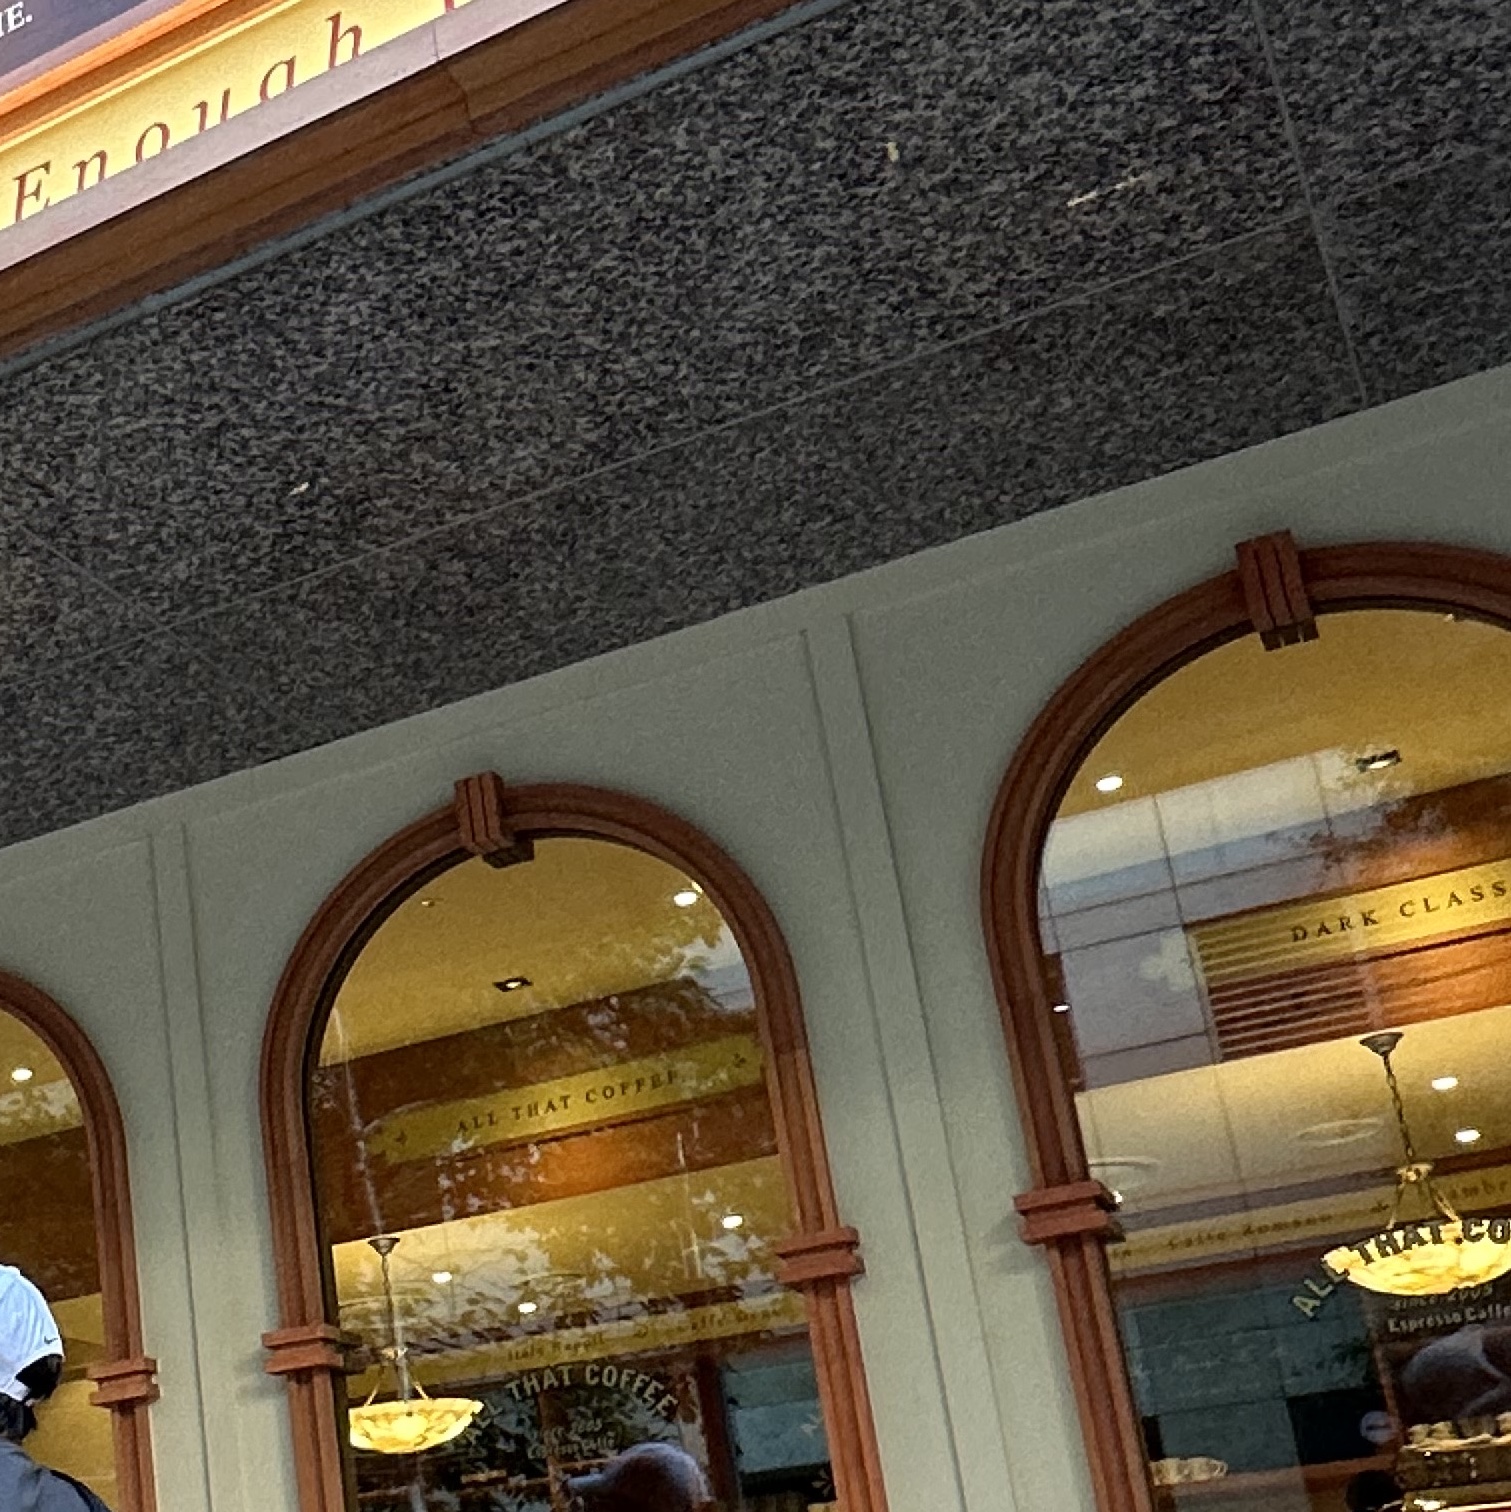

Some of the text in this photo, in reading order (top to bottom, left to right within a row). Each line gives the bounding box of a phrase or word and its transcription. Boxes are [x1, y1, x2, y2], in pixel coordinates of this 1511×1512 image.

[1290, 880, 1507, 942] DARK CLASS
[456, 1109, 498, 1134] ALL
[511, 1094, 571, 1121] THAT
[1291, 1257, 1351, 1319] ALL
[1351, 1221, 1445, 1267] THAT
[503, 1365, 573, 1401] THAT
[584, 1363, 680, 1424] COFFEE
